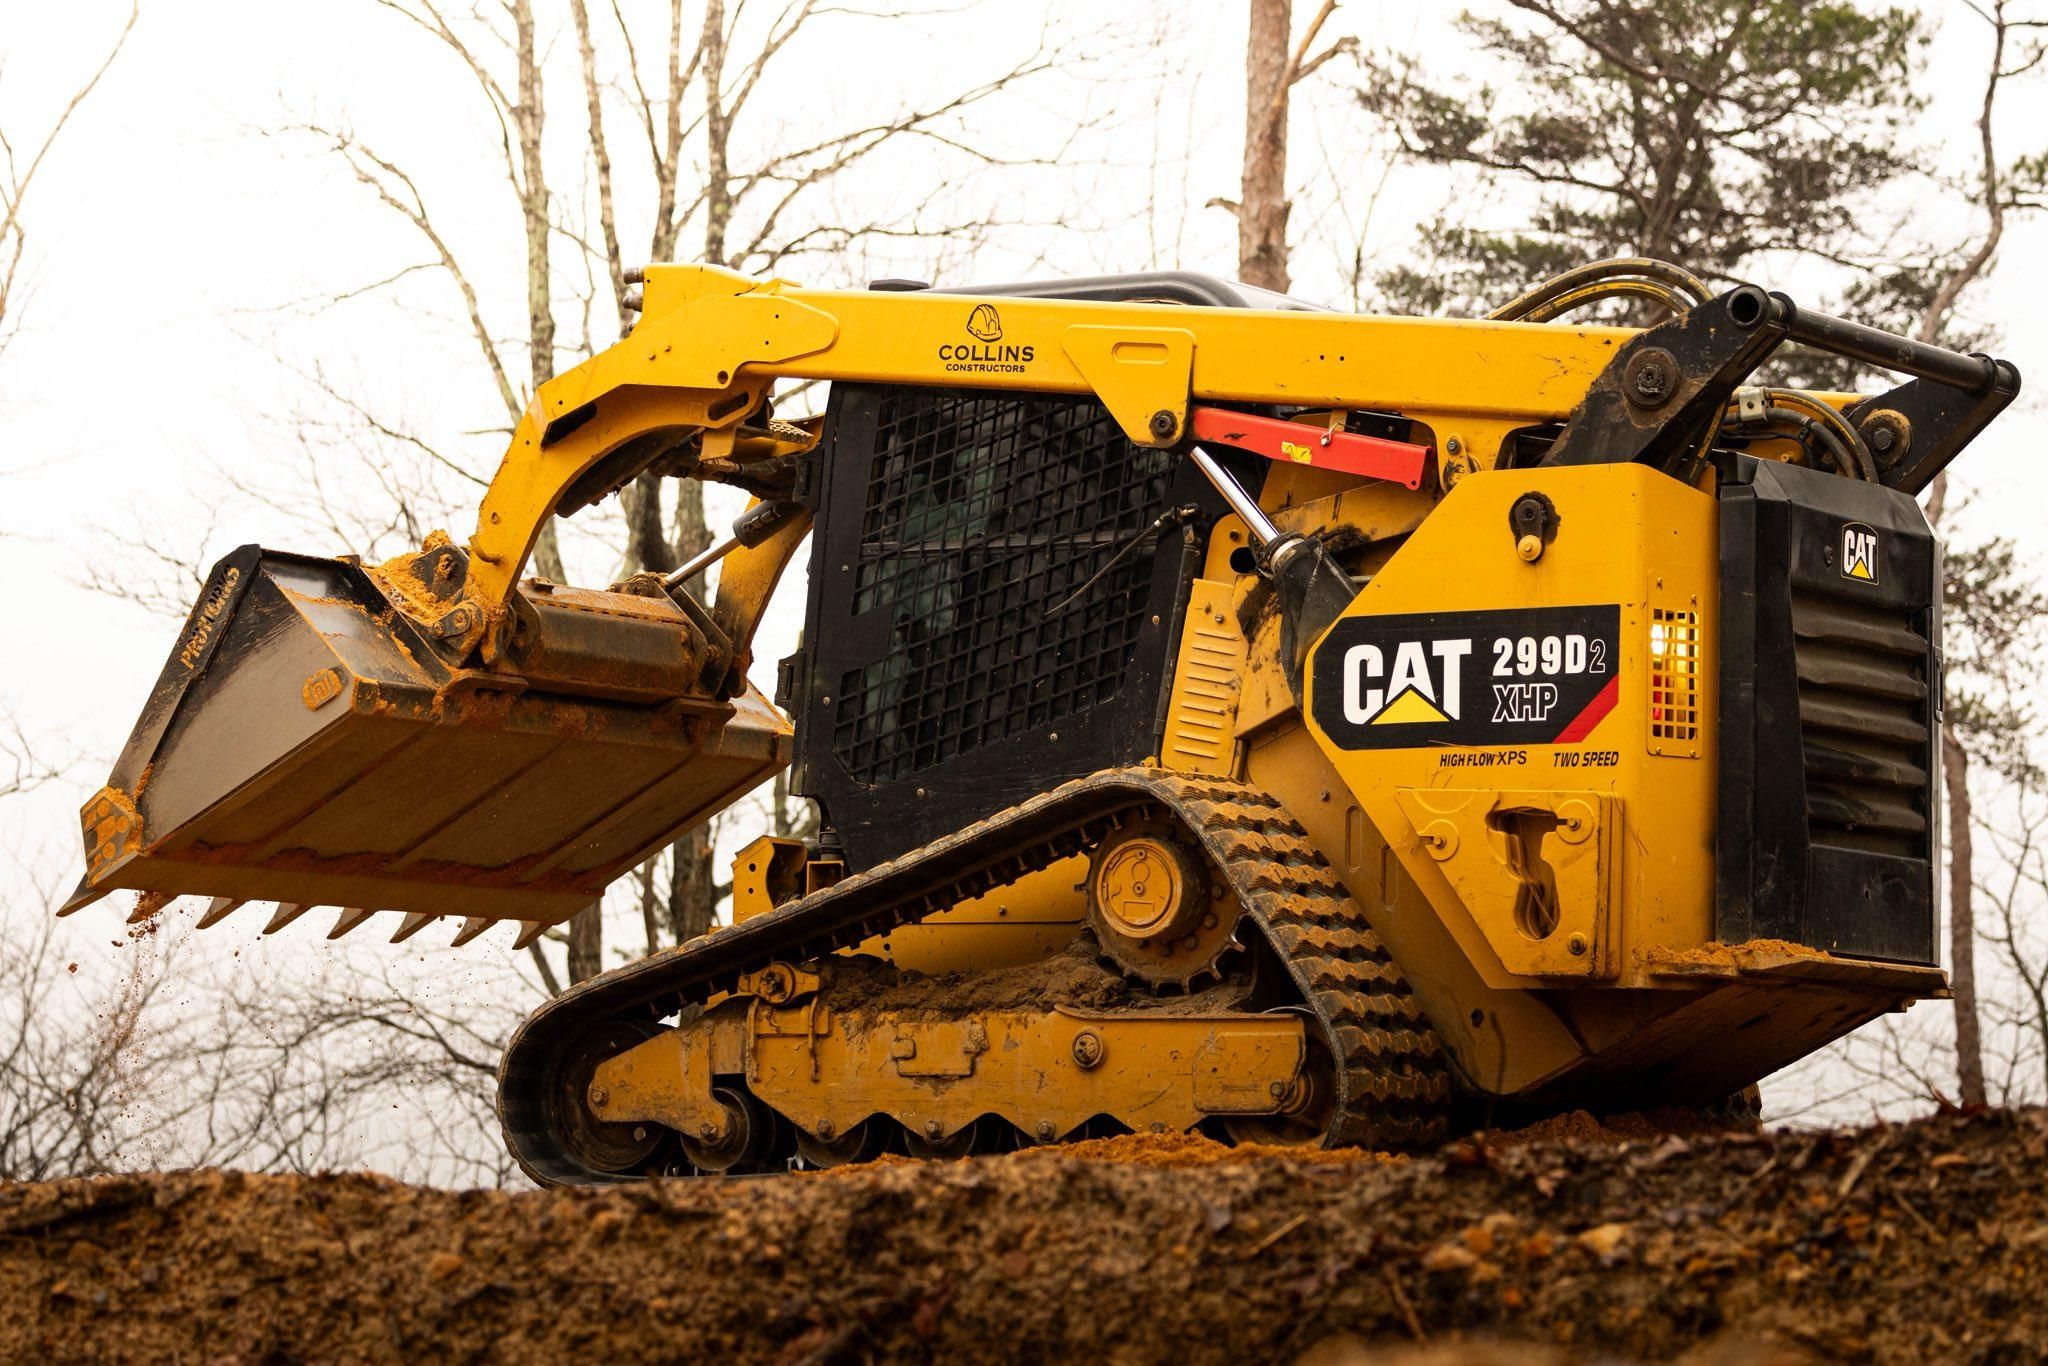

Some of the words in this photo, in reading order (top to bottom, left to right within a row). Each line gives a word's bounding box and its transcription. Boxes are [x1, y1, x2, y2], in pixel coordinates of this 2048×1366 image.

[939, 344, 1034, 362] COLLINS
[946, 364, 1026, 373] CONSTRUCTORS
[1843, 529, 1876, 579] CAT
[1493, 634, 1606, 676] 299D2
[1343, 638, 1472, 725] CAT
[1491, 683, 1558, 722] XHP
[1440, 753, 1465, 767] HIGH
[1467, 753, 1495, 767] FLOW
[1497, 751, 1528, 765] XPS
[1553, 752, 1580, 767] TWO
[1582, 751, 1619, 767] SPEED
